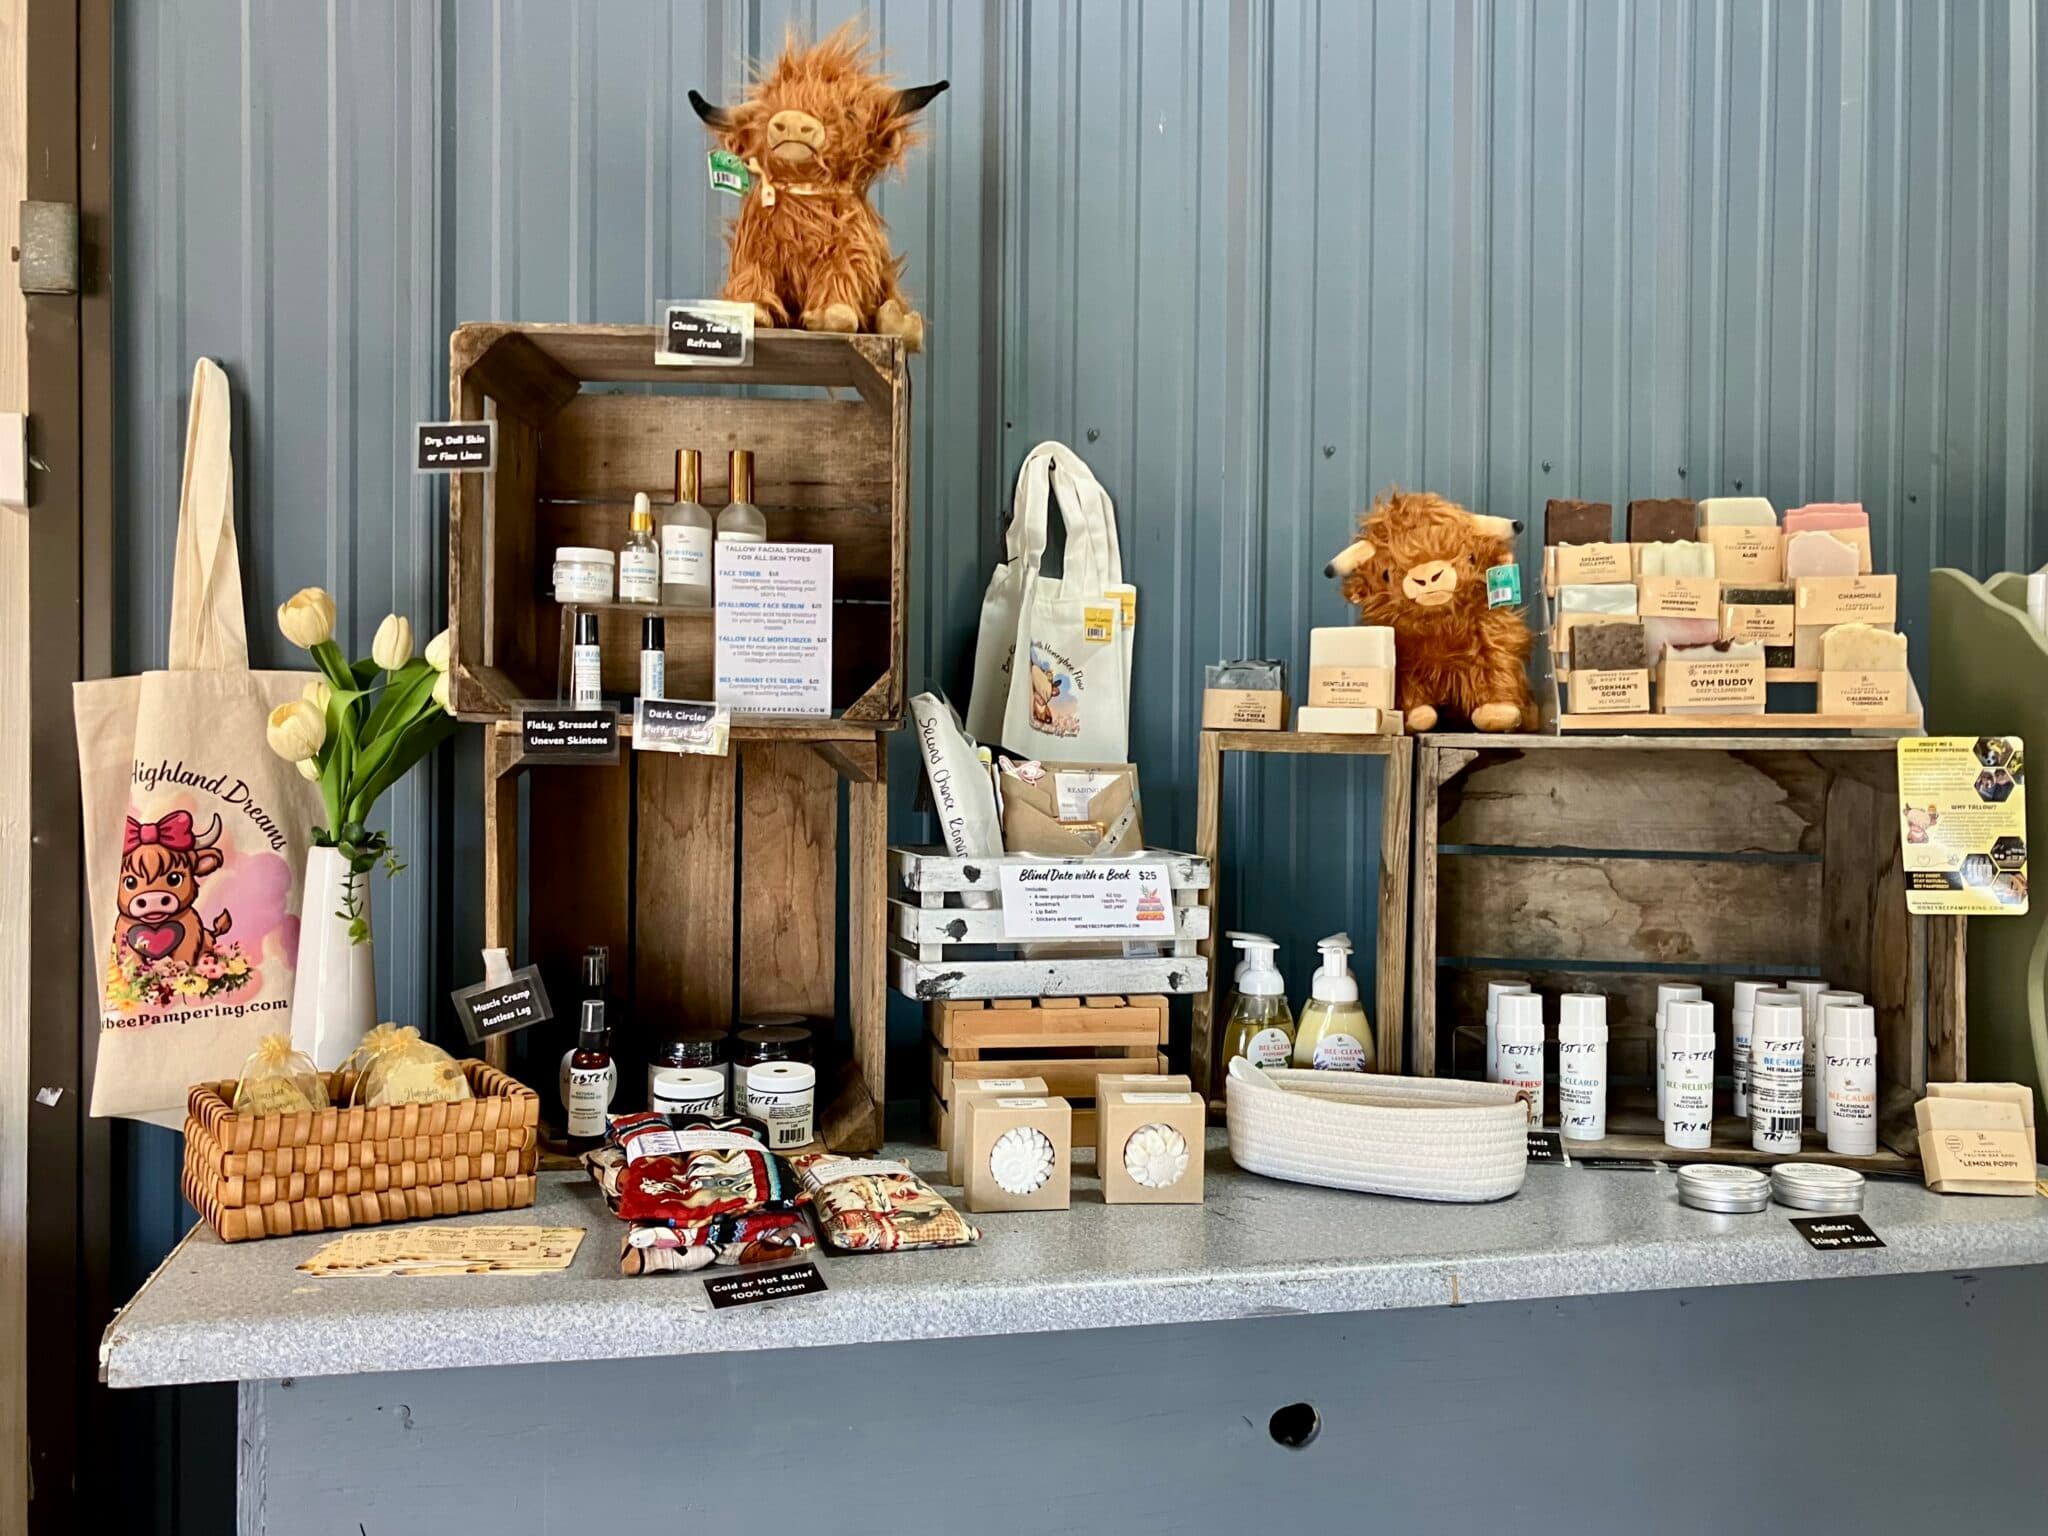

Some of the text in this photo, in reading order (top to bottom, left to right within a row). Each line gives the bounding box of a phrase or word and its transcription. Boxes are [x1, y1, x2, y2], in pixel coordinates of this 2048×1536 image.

[672, 321, 698, 331] Clean
[686, 338, 722, 349] Refresh
[424, 434, 485, 447] Dry, Dull Skin
[440, 452, 458, 460] Fine
[460, 450, 482, 460] Lines
[1591, 683, 1638, 691] WORKMAN'S
[1690, 678, 1754, 687] GYM BUDDY
[649, 709, 706, 722] Dark Circles
[526, 719, 611, 732] Flaky, Stressed or
[530, 735, 608, 745] Uneven Skintone
[933, 769, 955, 811] Chance
[222, 780, 288, 852] Dreams
[1019, 869, 1131, 882] Blind Date with a Book
[1138, 870, 1157, 881] $25
[472, 989, 531, 1014] Muscle Cramp
[482, 1005, 532, 1027] Restless Leg
[1560, 1042, 1596, 1054] ESTER
[1571, 1115, 1596, 1126] ME!
[1673, 1122, 1697, 1132] TRY
[1763, 1133, 1783, 1142] TRY
[1811, 1224, 1855, 1233] Splinters,
[1813, 1236, 1840, 1246] Stings
[712, 1269, 813, 1293] Cold or Hot Relief
[731, 1283, 805, 1300] 100% Cotton
